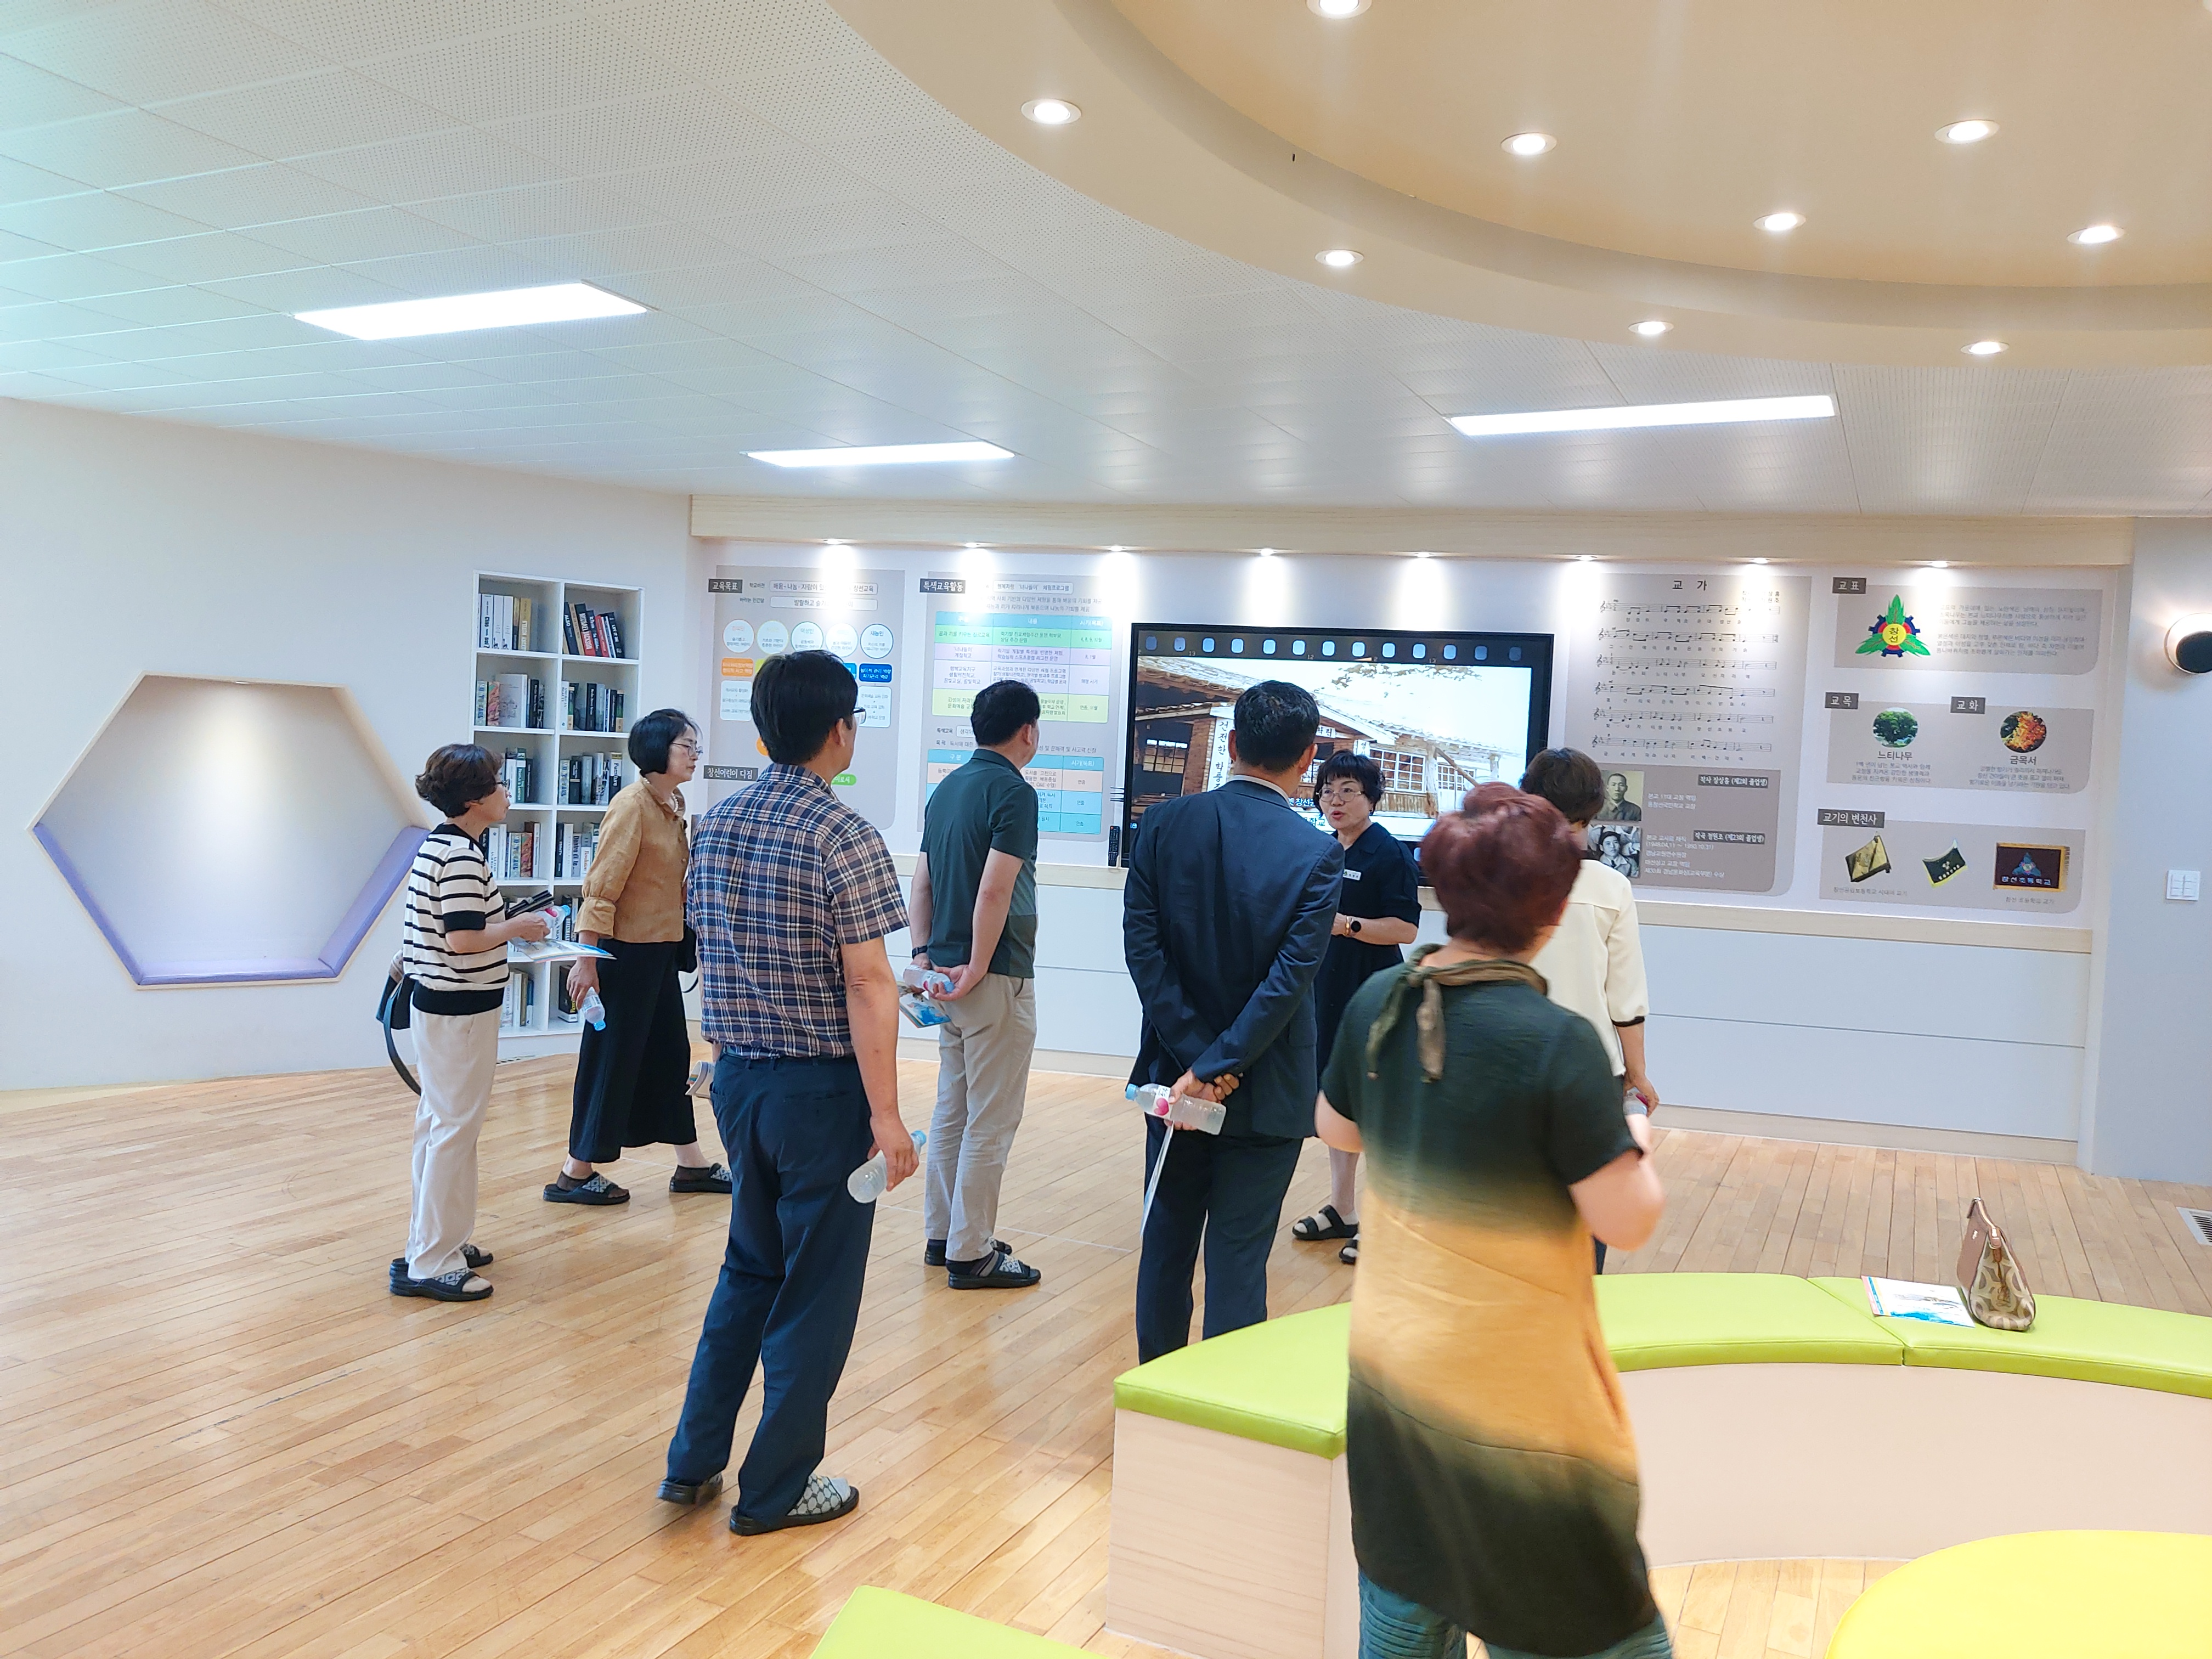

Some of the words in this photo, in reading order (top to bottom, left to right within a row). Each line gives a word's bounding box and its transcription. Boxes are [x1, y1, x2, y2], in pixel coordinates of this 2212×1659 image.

[712, 582, 738, 591] 교육목표
[923, 581, 963, 592] 특색교육활동
[579, 613, 589, 631] MICHAEL
[583, 630, 592, 650] JACKSON
[1889, 627, 1899, 643] 창선
[1218, 721, 1228, 755] 건전한
[1877, 751, 1912, 760] 느티나무
[2010, 755, 2036, 765] 금목서
[707, 769, 738, 778] 창선어린이
[740, 770, 753, 779] 다짐
[1822, 812, 1848, 823] 교기의
[1852, 814, 1877, 825] 변천사
